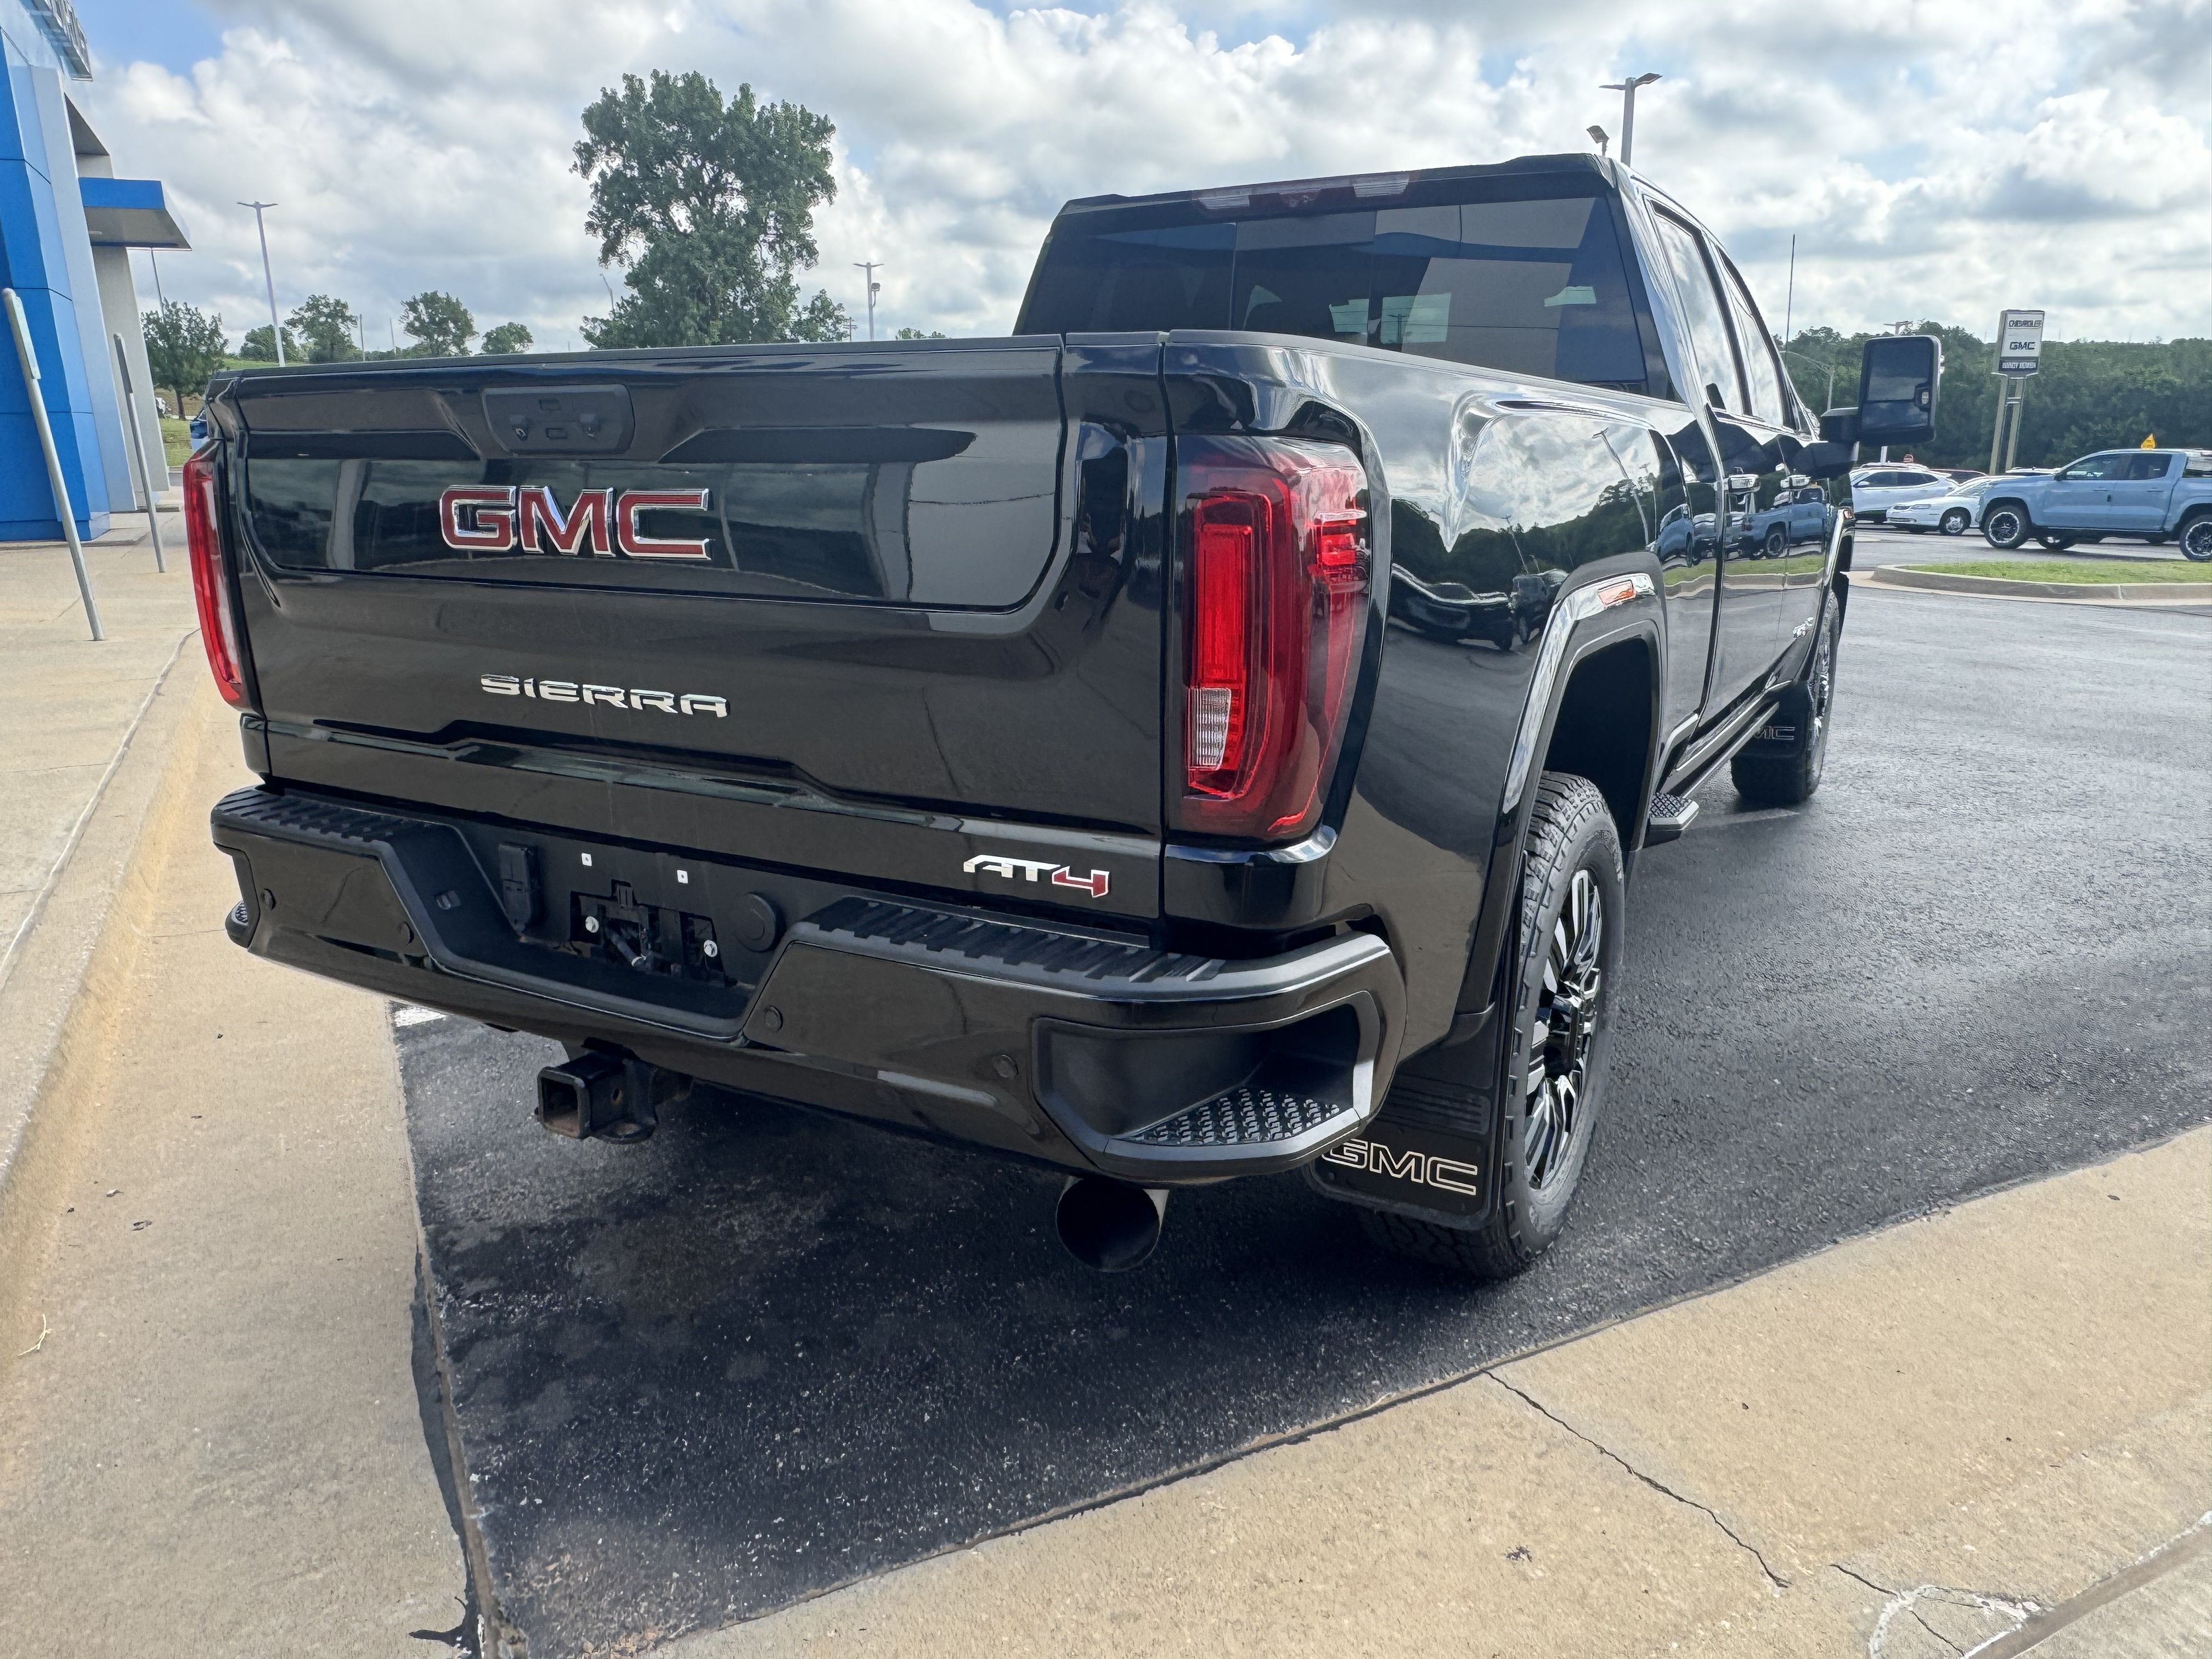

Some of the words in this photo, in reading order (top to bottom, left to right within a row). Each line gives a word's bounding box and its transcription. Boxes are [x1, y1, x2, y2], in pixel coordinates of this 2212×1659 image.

[2010, 341, 2035, 350] GMC
[439, 484, 712, 561] GMC
[481, 674, 730, 718] SIERRA
[963, 854, 1111, 899] AT4
[1321, 1138, 1479, 1197] GMC
